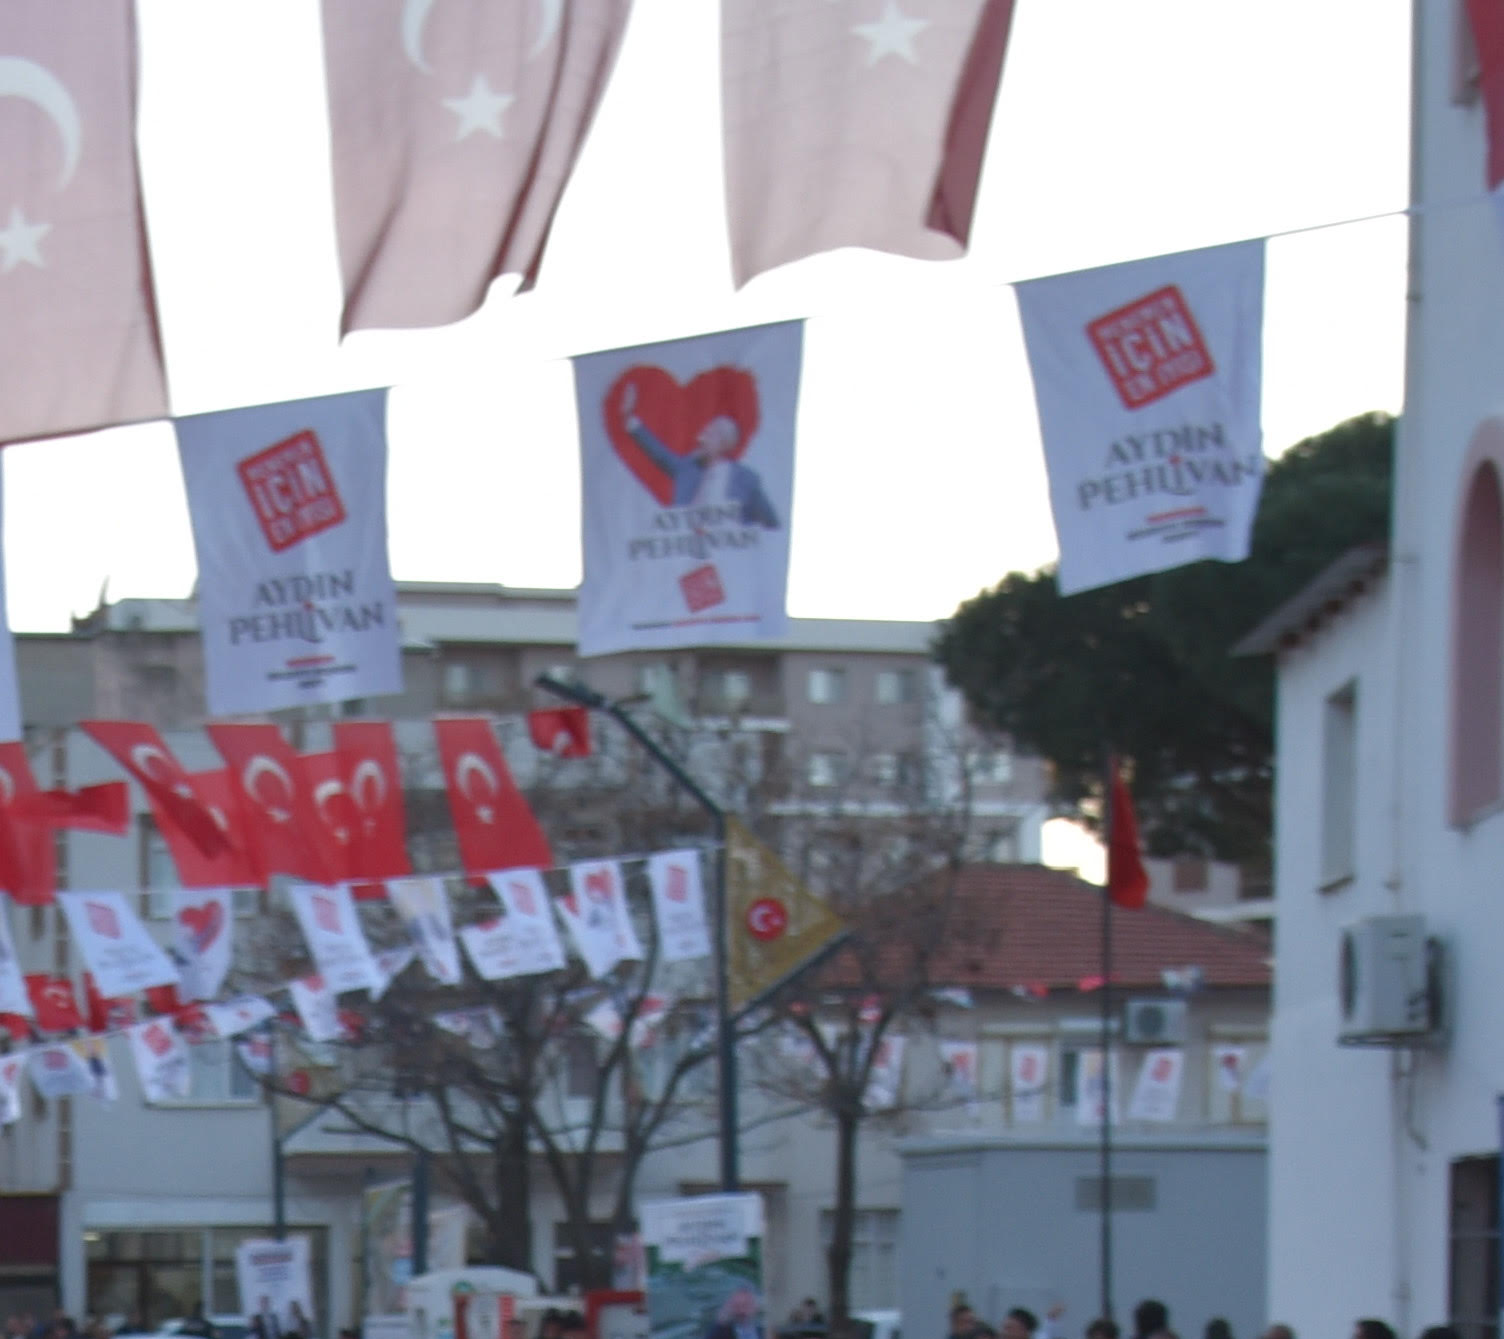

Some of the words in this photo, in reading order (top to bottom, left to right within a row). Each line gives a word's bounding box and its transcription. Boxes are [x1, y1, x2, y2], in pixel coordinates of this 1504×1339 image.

[1104, 421, 1229, 469] AYDIN
[1076, 452, 1262, 512] PEHLİVAN
[256, 569, 355, 607] AYDIN
[228, 601, 386, 646] PEHLİVAN
